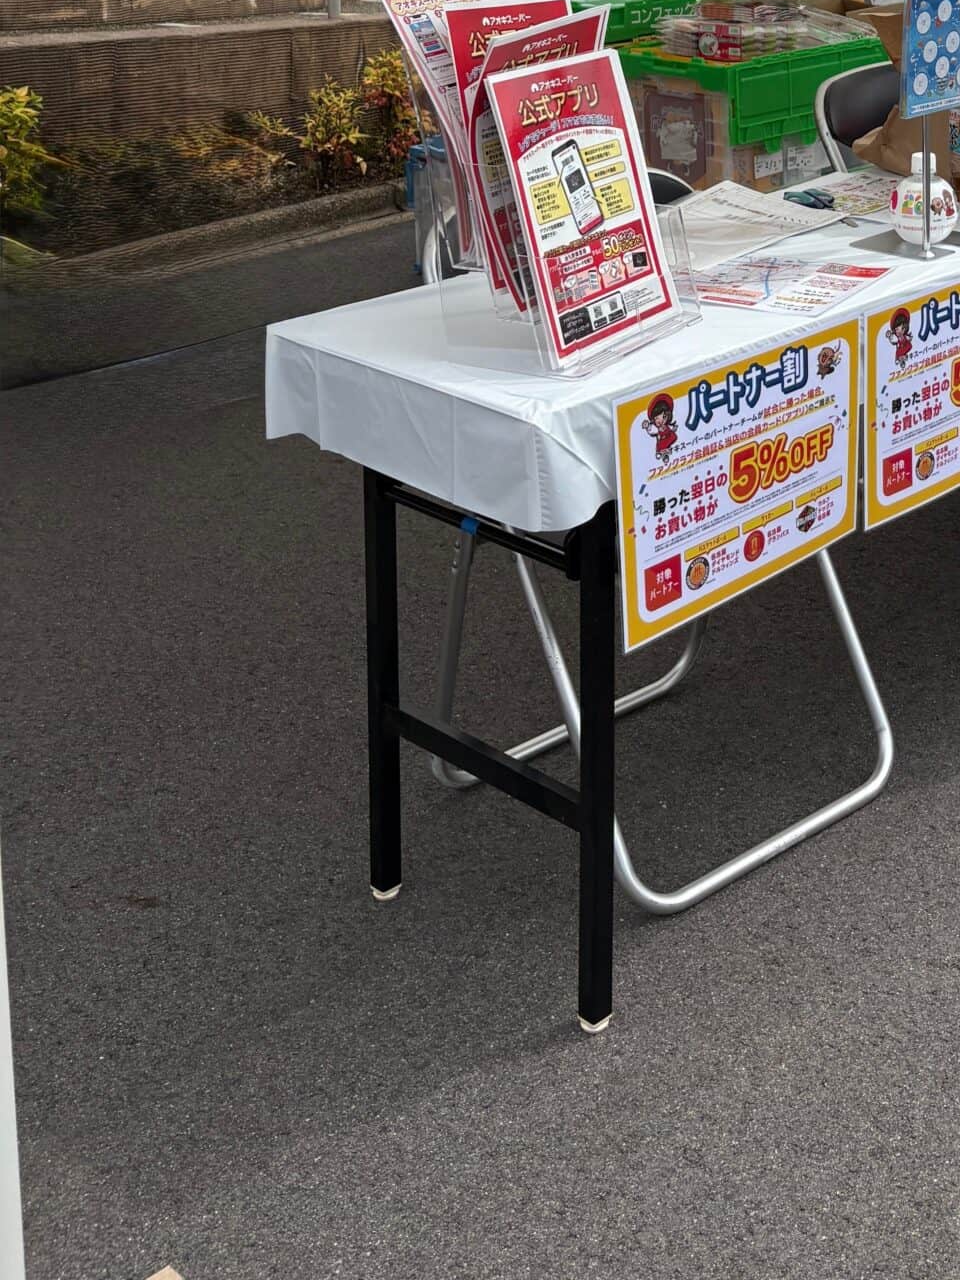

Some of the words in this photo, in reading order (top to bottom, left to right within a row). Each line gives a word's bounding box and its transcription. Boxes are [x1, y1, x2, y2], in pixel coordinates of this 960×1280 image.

[518, 83, 599, 126] 公式アプリ
[685, 345, 809, 431] パートナー割
[728, 423, 835, 504] 5%OFF
[653, 472, 728, 517] 勝った翌日の
[655, 498, 718, 541] お買い物が
[650, 581, 679, 601] パートナー
[656, 569, 672, 583] 対象
